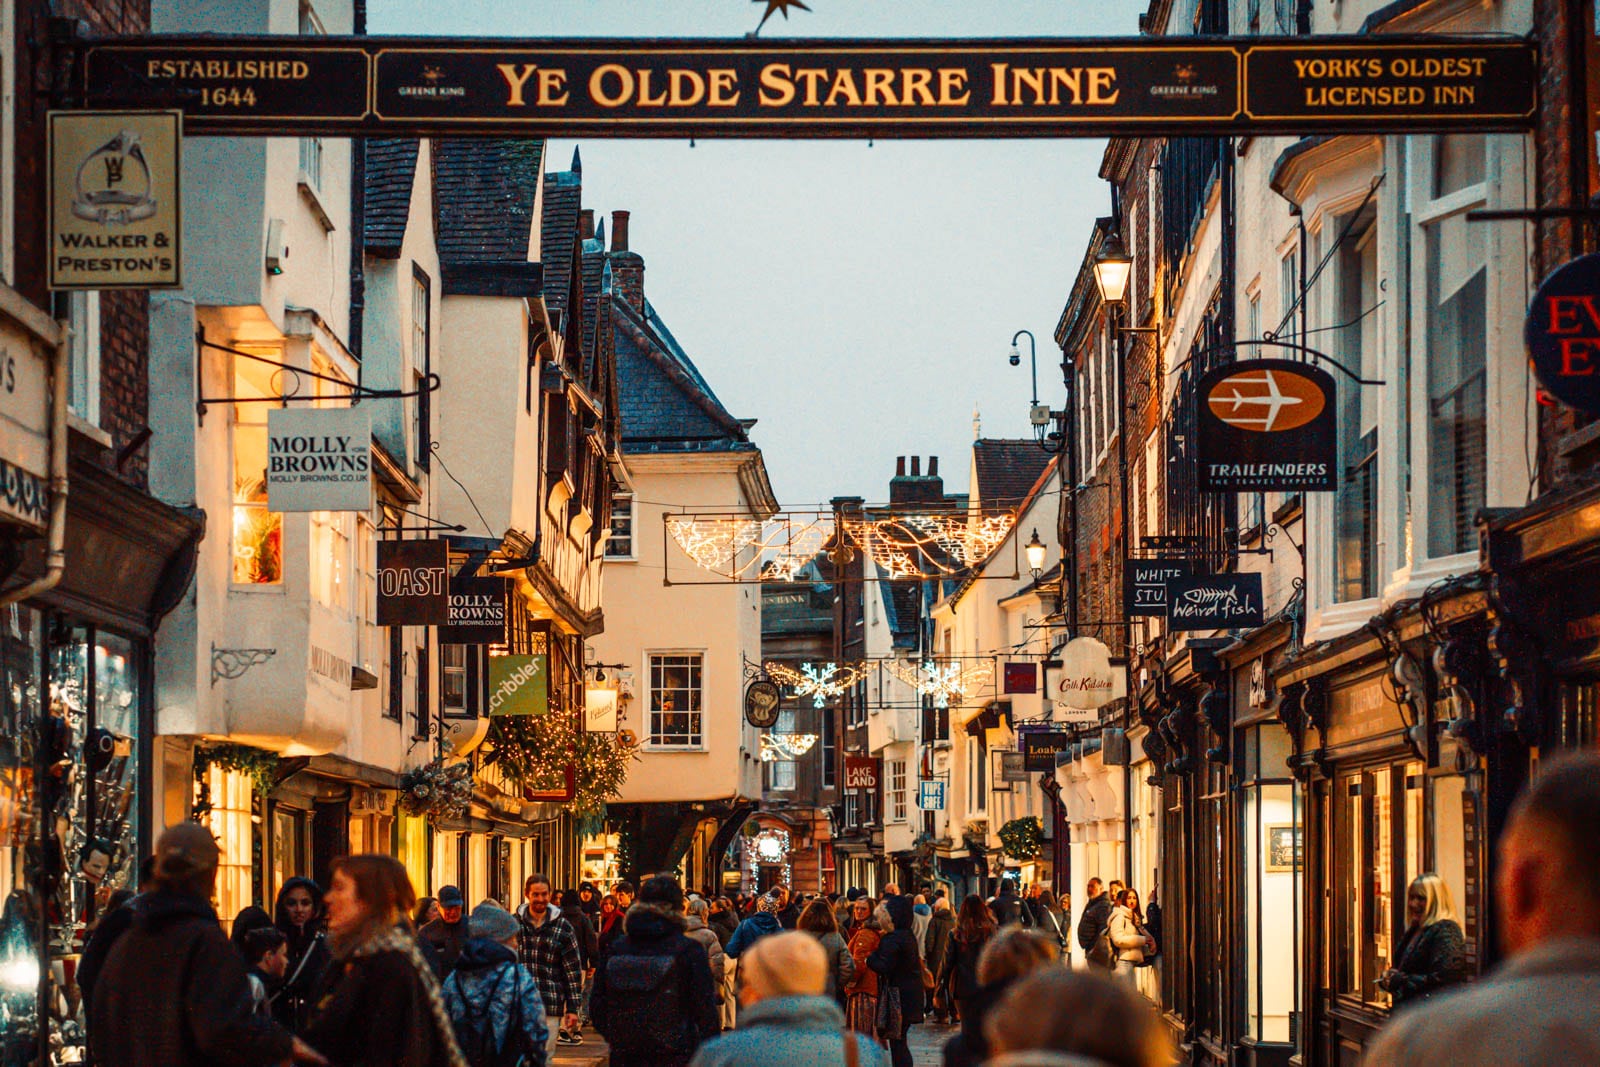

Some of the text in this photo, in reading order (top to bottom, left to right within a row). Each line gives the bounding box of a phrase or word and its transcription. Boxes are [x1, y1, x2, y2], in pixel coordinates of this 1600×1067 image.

[147, 60, 309, 79] ESTABLISHED
[1294, 57, 1487, 78] YORK'S OLDEST
[398, 86, 465, 96] GREENE KING
[497, 63, 1120, 107] YE OLDE STARRE INNE
[1150, 86, 1218, 96] GREENE KING
[201, 87, 257, 106] 1644
[1305, 86, 1476, 106] LICENSED INN
[60, 232, 169, 248] WALKER &
[58, 256, 172, 271] PRESTON'S
[1558, 338, 1600, 377] E
[270, 436, 351, 454] MOLLY
[271, 455, 368, 472] BROWNS
[1208, 463, 1327, 477] TRAILFINDERS
[270, 475, 298, 483] MOLLY
[377, 568, 445, 596] OAST
[1135, 589, 1162, 602] STU
[449, 607, 504, 619] ROWNS
[1173, 594, 1257, 619] Weird fish
[1060, 678, 1079, 693] Cath
[846, 767, 872, 777] LAKE
[847, 777, 876, 787] LAND
